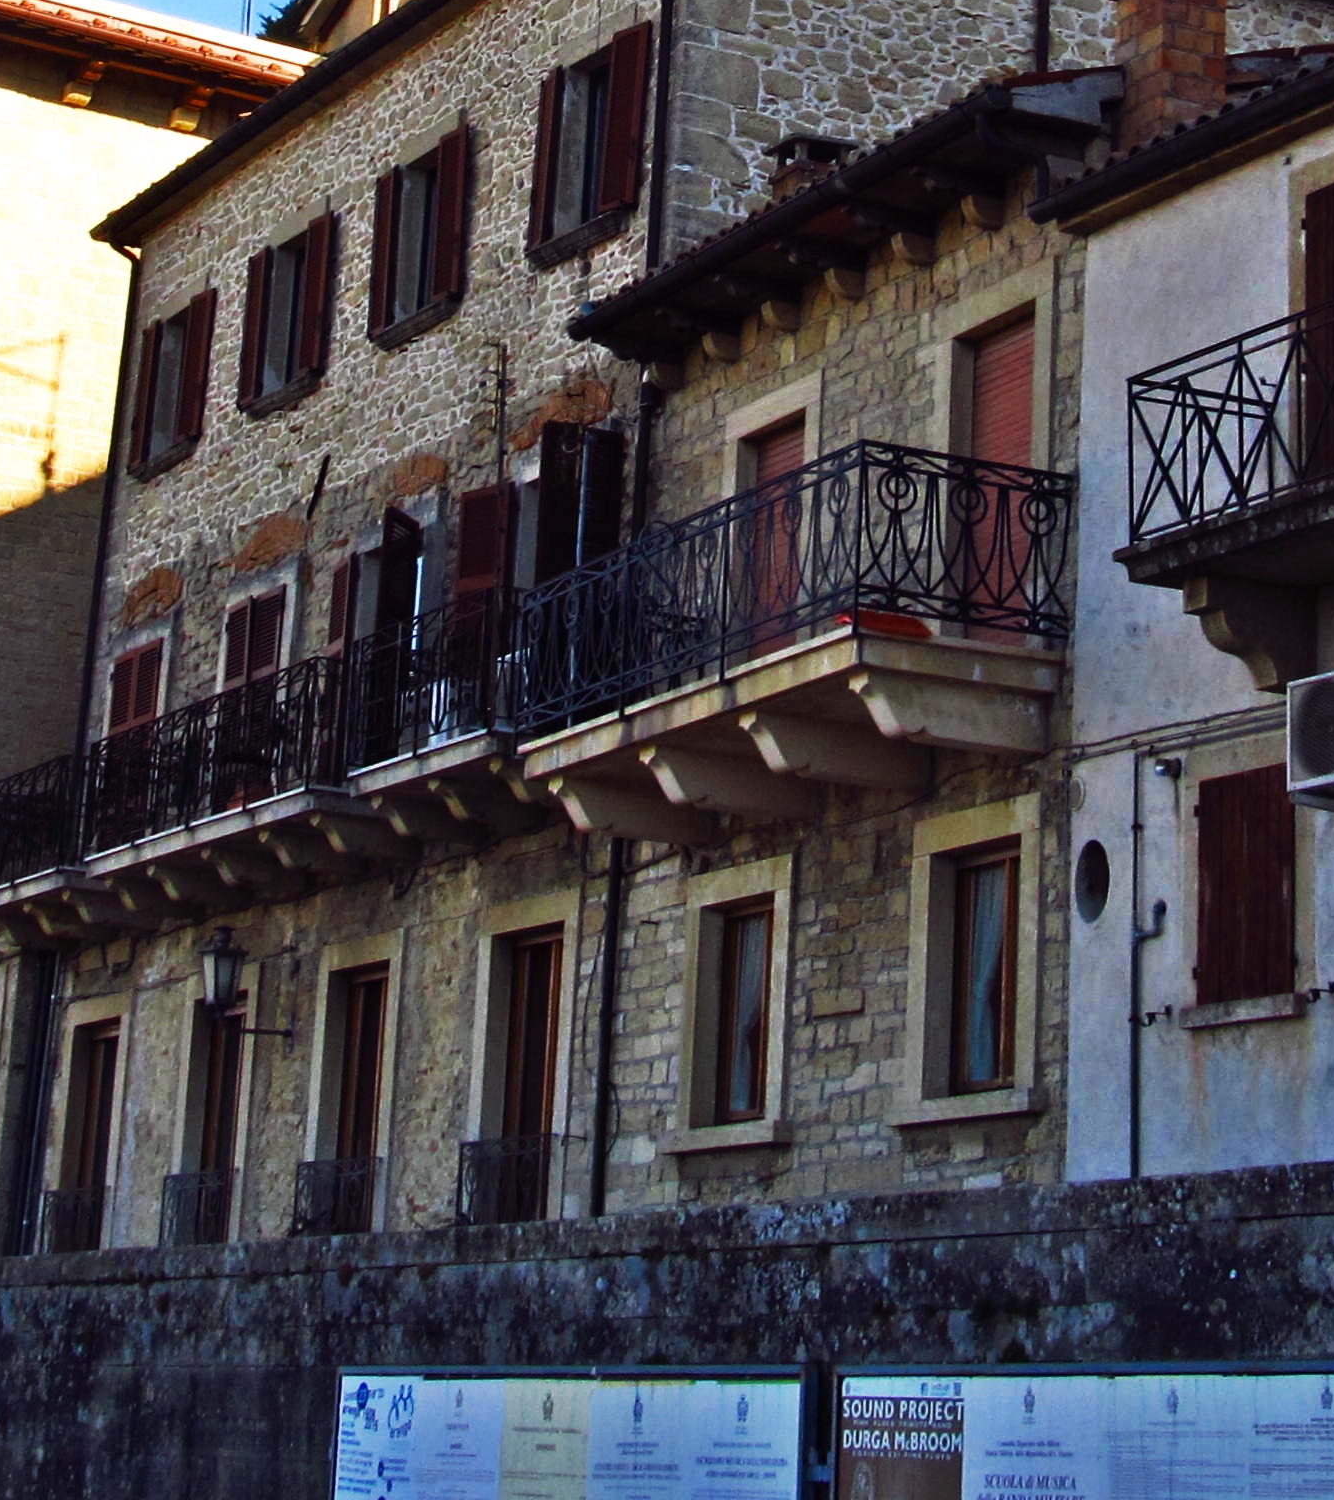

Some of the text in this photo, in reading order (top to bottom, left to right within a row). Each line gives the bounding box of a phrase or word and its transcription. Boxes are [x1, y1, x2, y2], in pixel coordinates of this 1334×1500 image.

[842, 1399, 964, 1425] SOUND PROJECT
[842, 1429, 963, 1452] DURGA McBROOM
[984, 1474, 1023, 1489] SCUOLA
[1035, 1475, 1077, 1490] MUSICA
